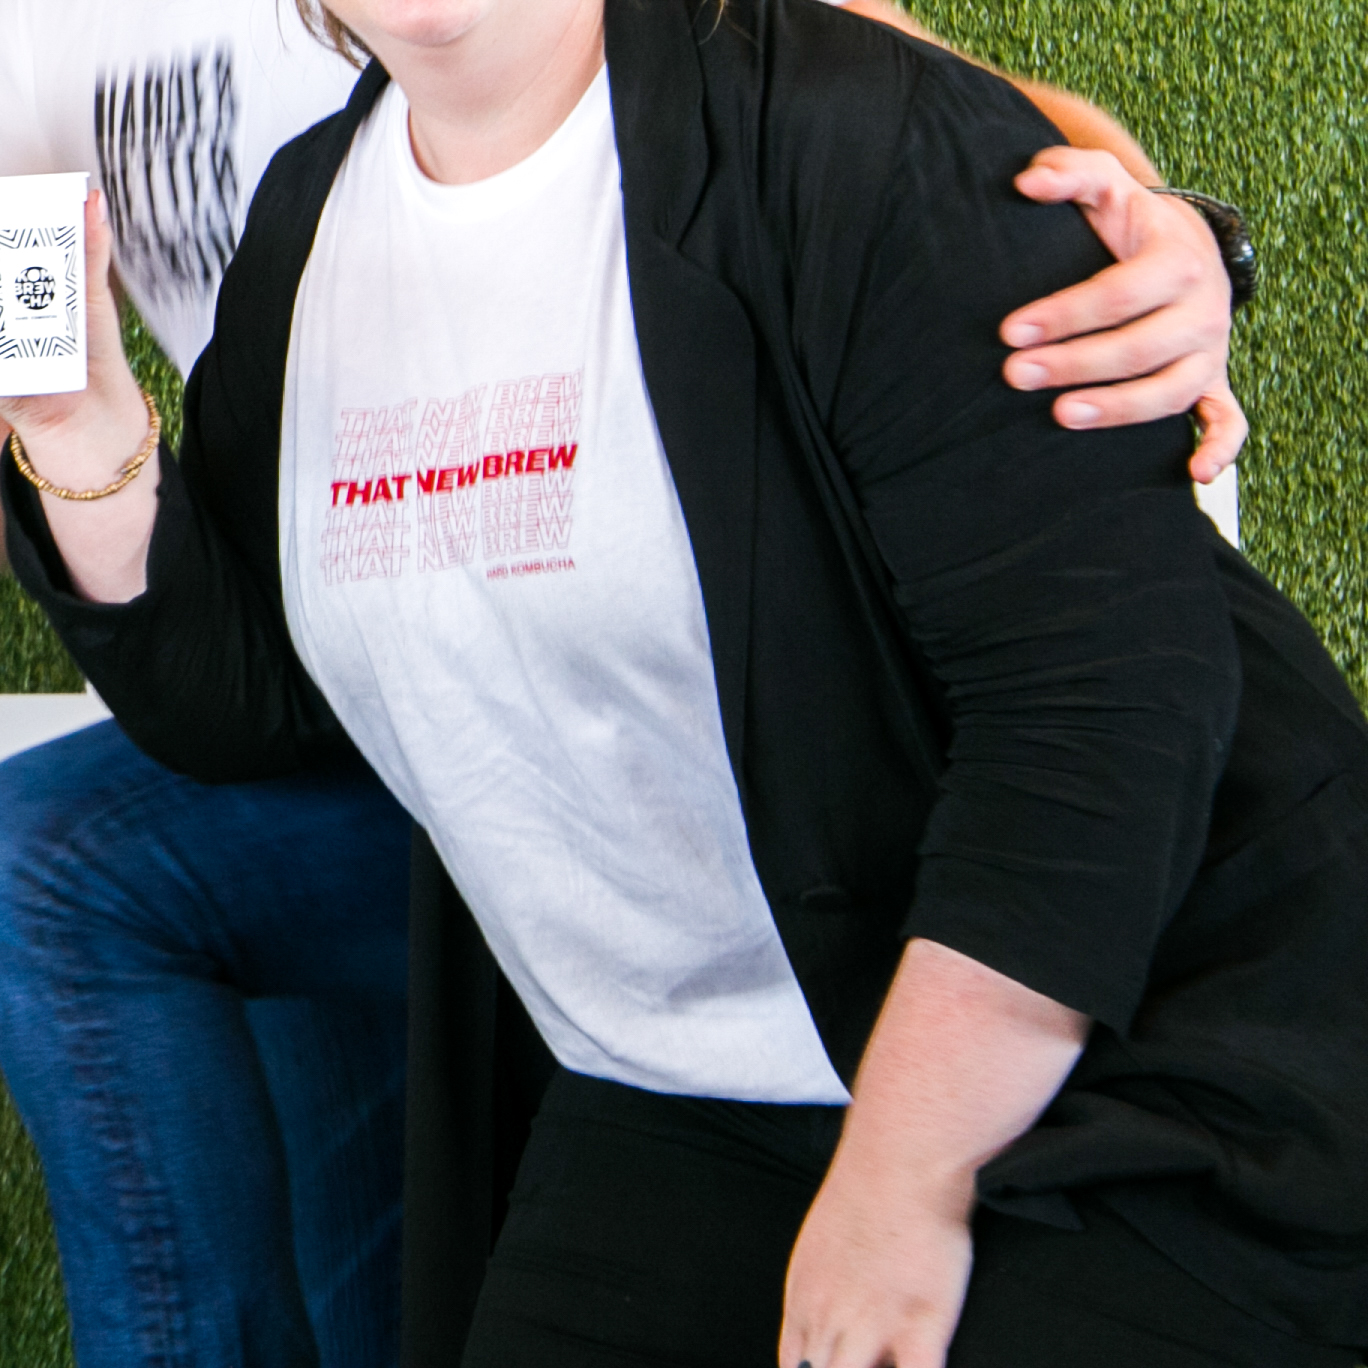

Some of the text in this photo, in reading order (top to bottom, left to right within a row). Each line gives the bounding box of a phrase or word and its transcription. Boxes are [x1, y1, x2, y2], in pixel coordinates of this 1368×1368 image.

[14, 268, 55, 282] KOM
[17, 294, 54, 309] CHA
[341, 369, 582, 436] THAT NEW BREW
[331, 443, 578, 507] THAT NEW BREW
[320, 517, 573, 585] THAT NEW BREW
[511, 556, 576, 577] KOMBUCHA
